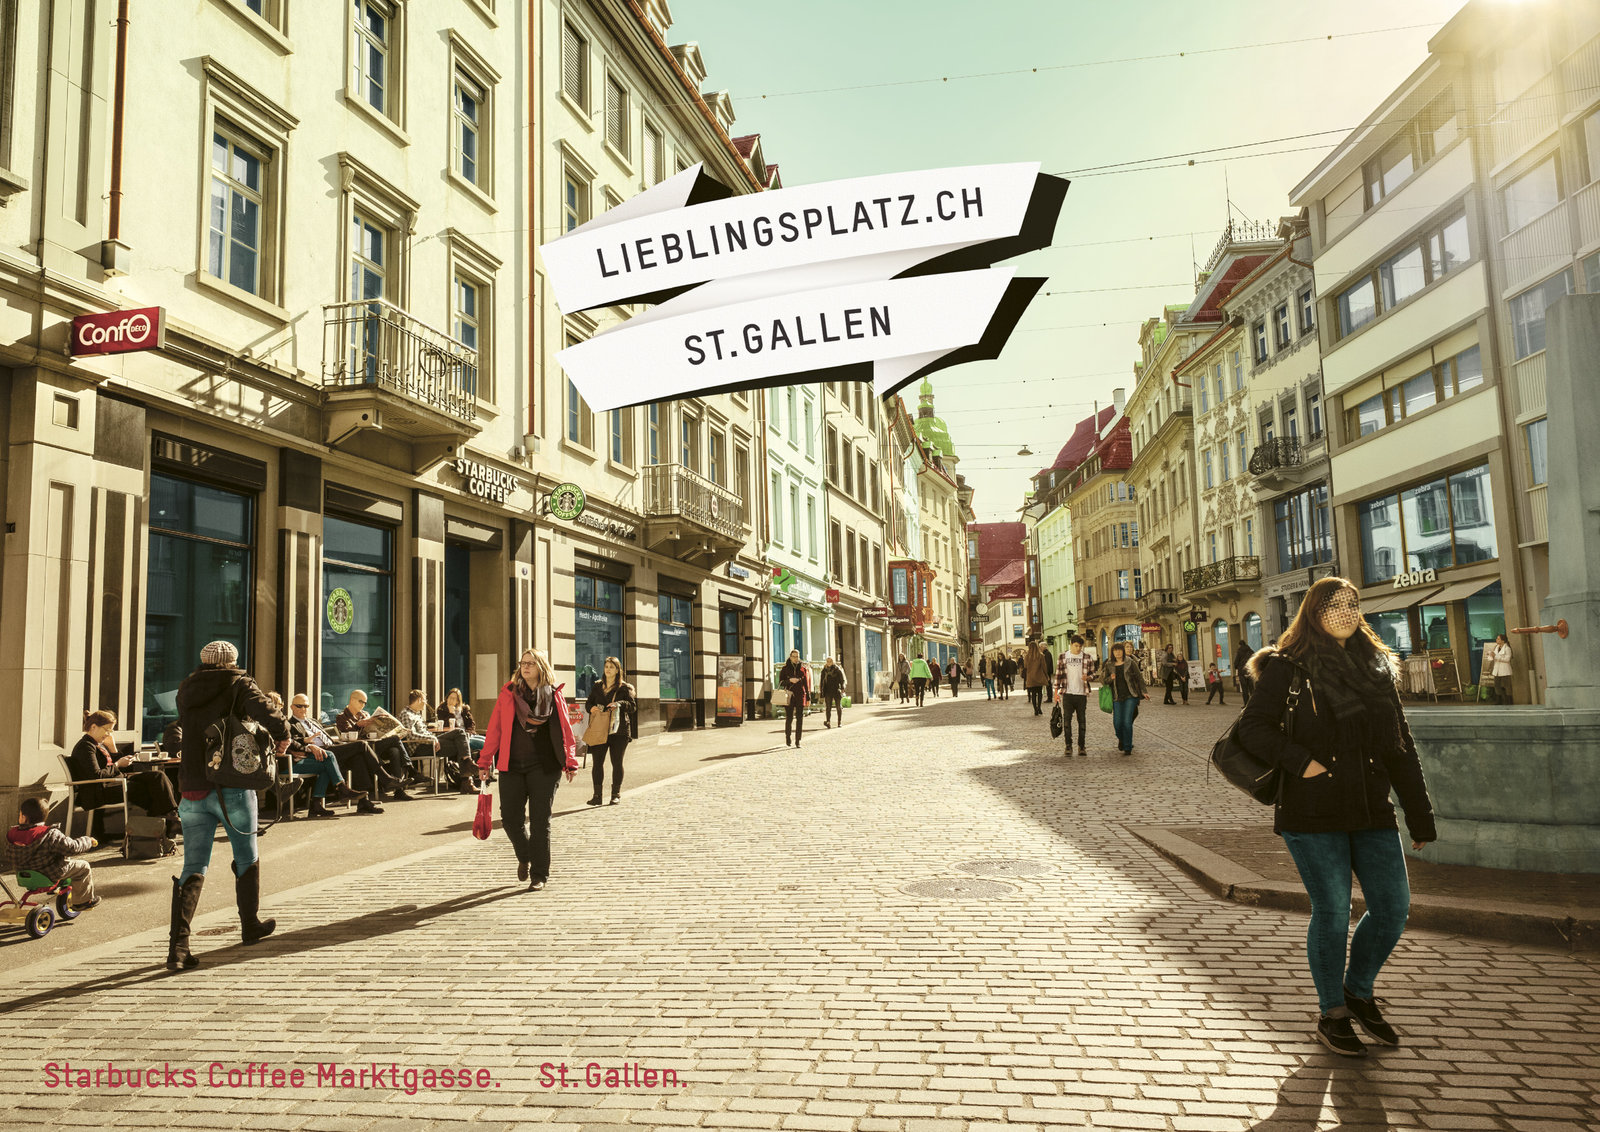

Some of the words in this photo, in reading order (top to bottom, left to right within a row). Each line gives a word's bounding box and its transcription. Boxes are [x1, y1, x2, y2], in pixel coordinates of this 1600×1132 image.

[456, 459, 519, 492] STARBUCKS
[1466, 466, 1484, 478] zebra
[470, 478, 510, 504] COFFEE
[552, 485, 583, 500] STARBUCKS
[1414, 485, 1431, 495] zebra
[1370, 500, 1385, 510] zebra
[554, 508, 578, 518] COFFEE
[1392, 568, 1436, 589] zebra
[329, 589, 353, 611] STARBUCKS
[331, 618, 350, 632] COFFEE
